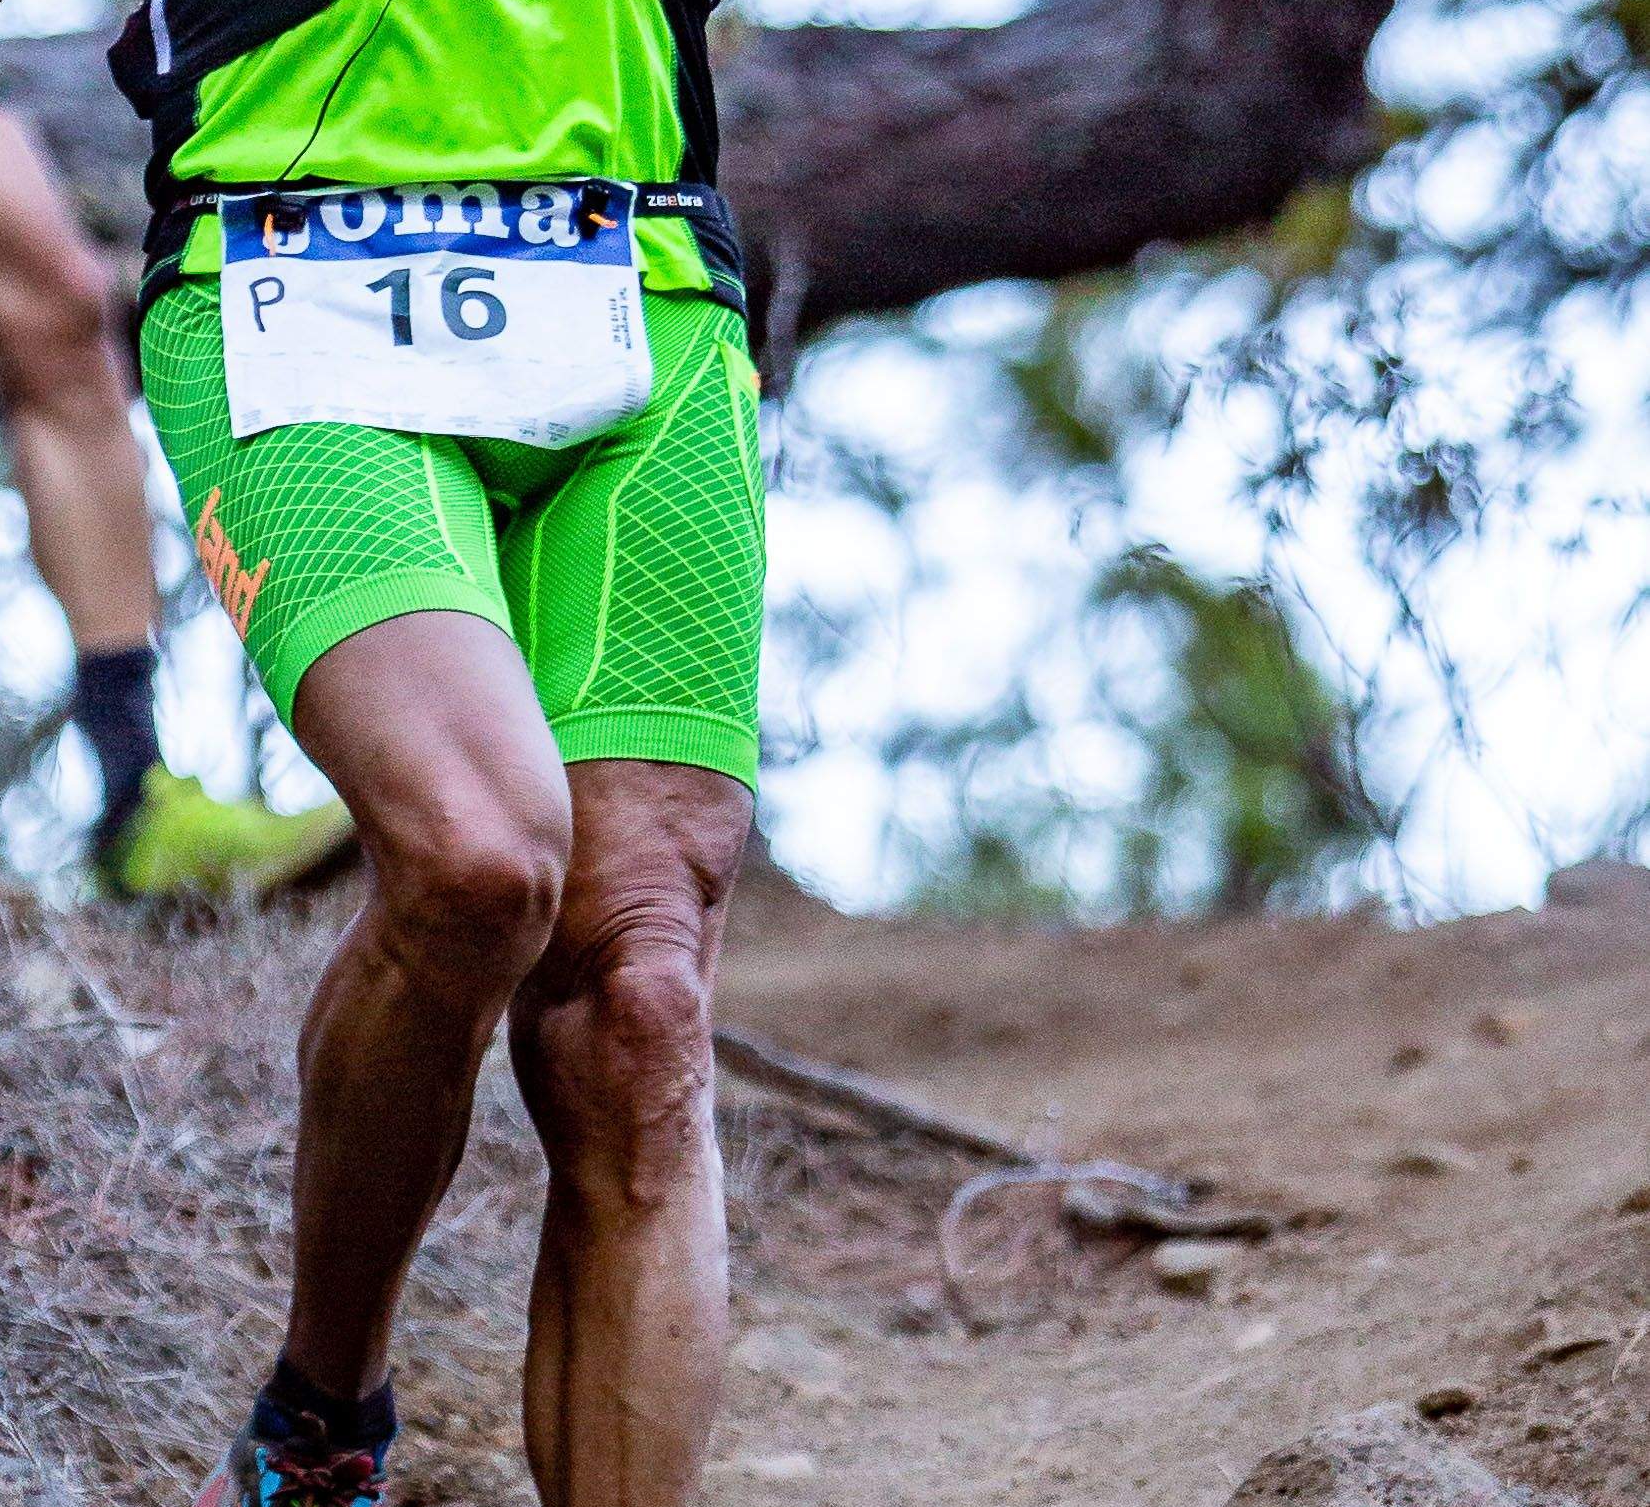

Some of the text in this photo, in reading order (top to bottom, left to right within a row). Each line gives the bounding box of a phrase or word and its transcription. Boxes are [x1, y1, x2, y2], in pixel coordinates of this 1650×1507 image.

[646, 192, 704, 207] zeebra
[249, 276, 285, 332] P
[364, 266, 508, 347] 16
